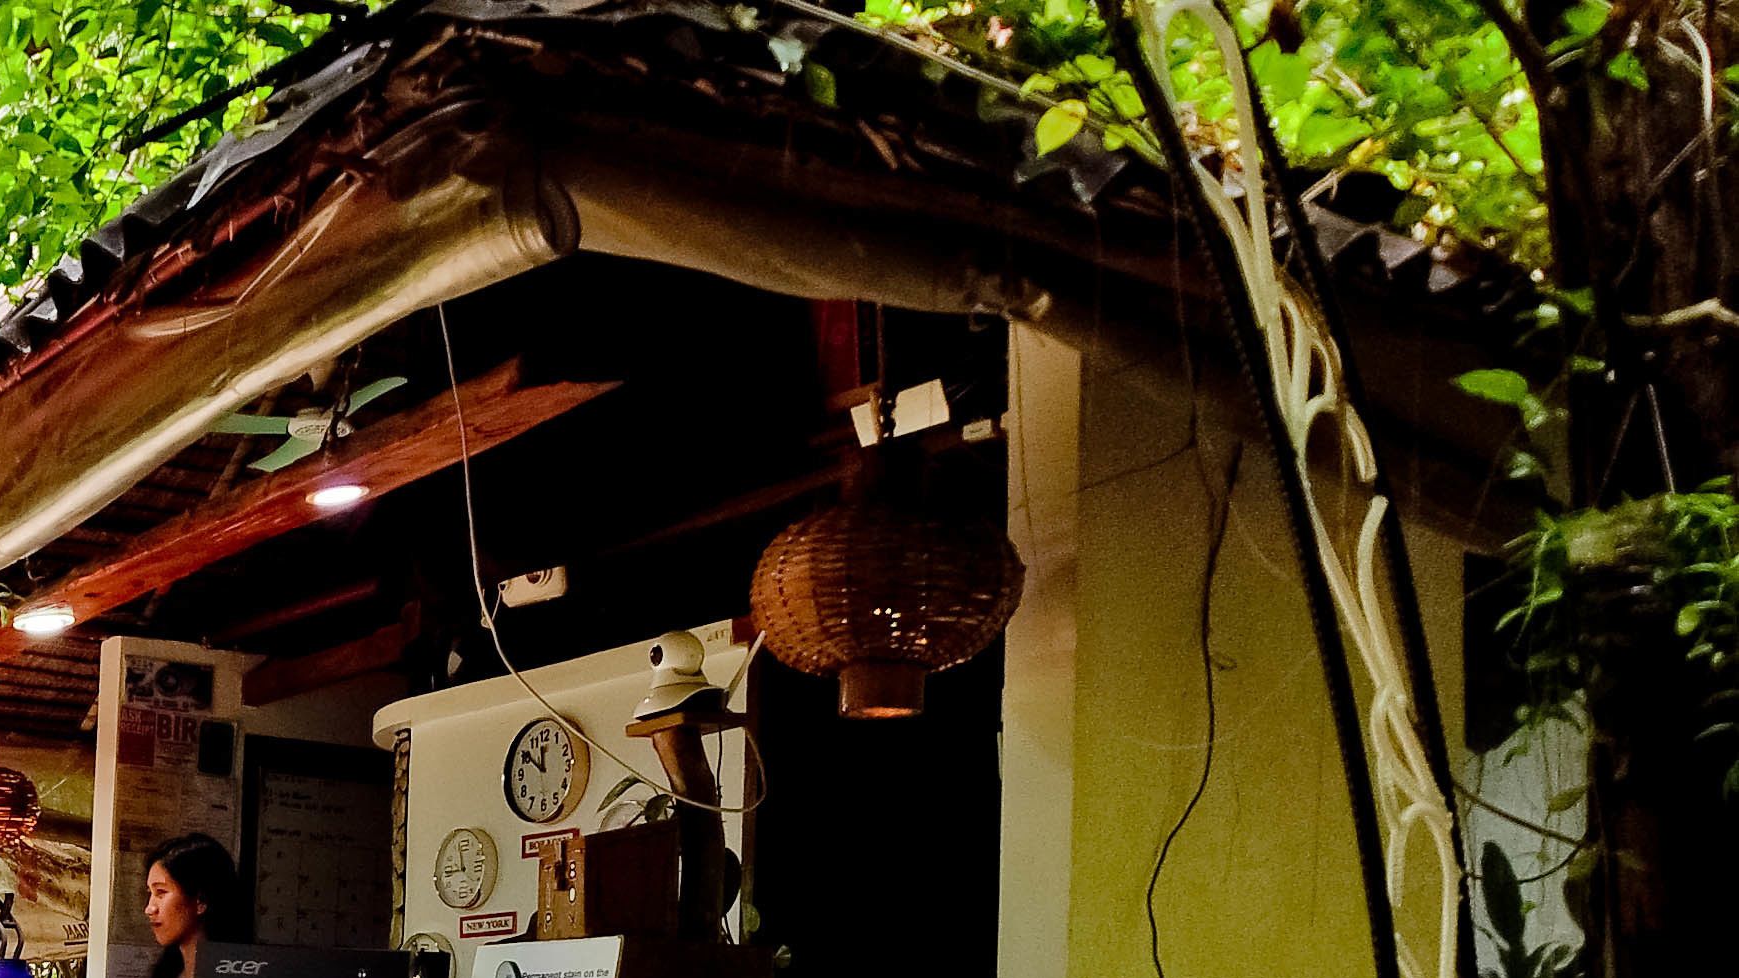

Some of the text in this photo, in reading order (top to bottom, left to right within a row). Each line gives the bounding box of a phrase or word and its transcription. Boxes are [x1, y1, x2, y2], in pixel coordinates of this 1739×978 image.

[157, 712, 198, 741] BIR
[540, 728, 550, 742] 12
[554, 731, 559, 744] 1
[530, 736, 539, 749] 11
[562, 743, 569, 757] 2
[564, 758, 571, 772] 3
[517, 767, 524, 781] 9
[521, 784, 527, 798] 8
[561, 777, 568, 791] 4
[528, 796, 535, 810] 7
[541, 798, 547, 811] 6
[552, 792, 559, 806] 5
[466, 919, 510, 931] NEW YORK
[215, 959, 269, 975] acer
[596, 969, 609, 977] the
